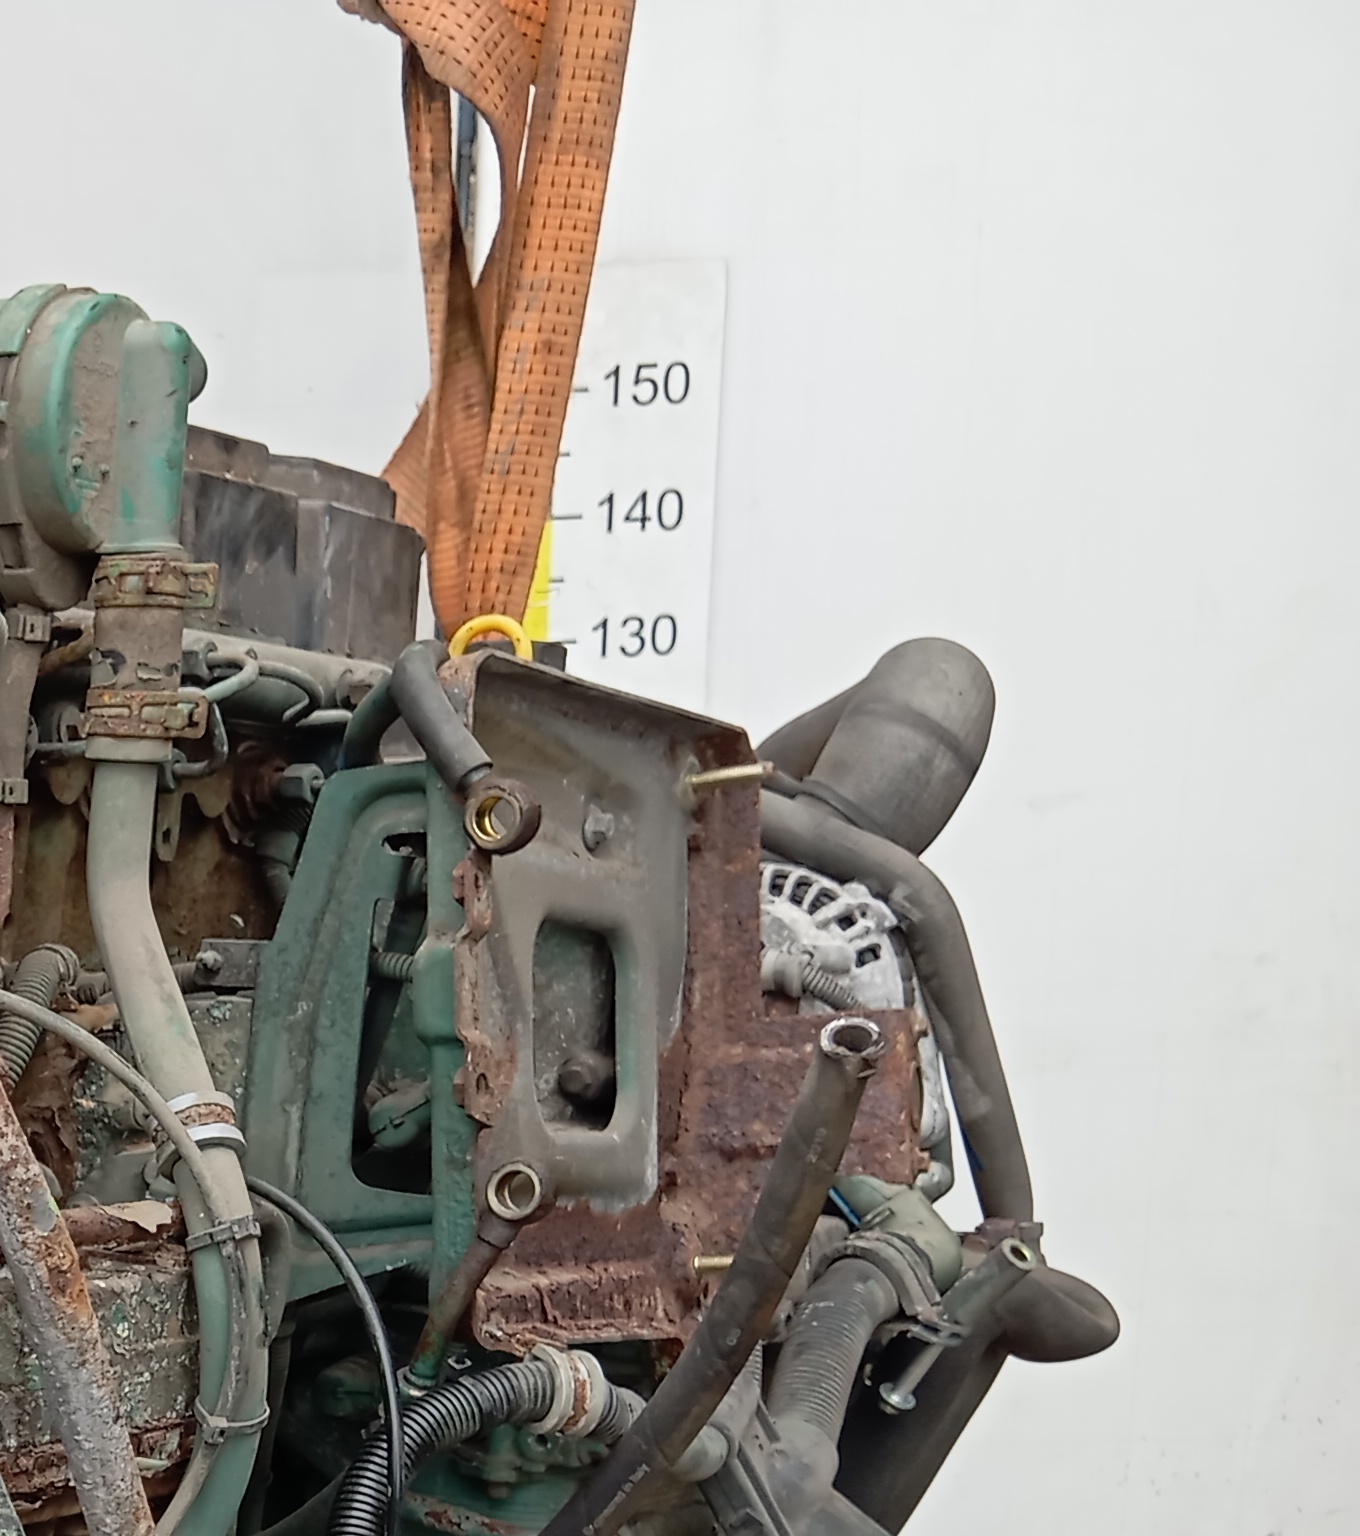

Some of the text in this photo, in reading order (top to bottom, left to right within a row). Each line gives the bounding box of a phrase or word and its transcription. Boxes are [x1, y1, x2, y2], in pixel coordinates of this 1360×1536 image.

[604, 361, 690, 407] 150
[598, 488, 683, 534] 140
[592, 614, 677, 658] 130
